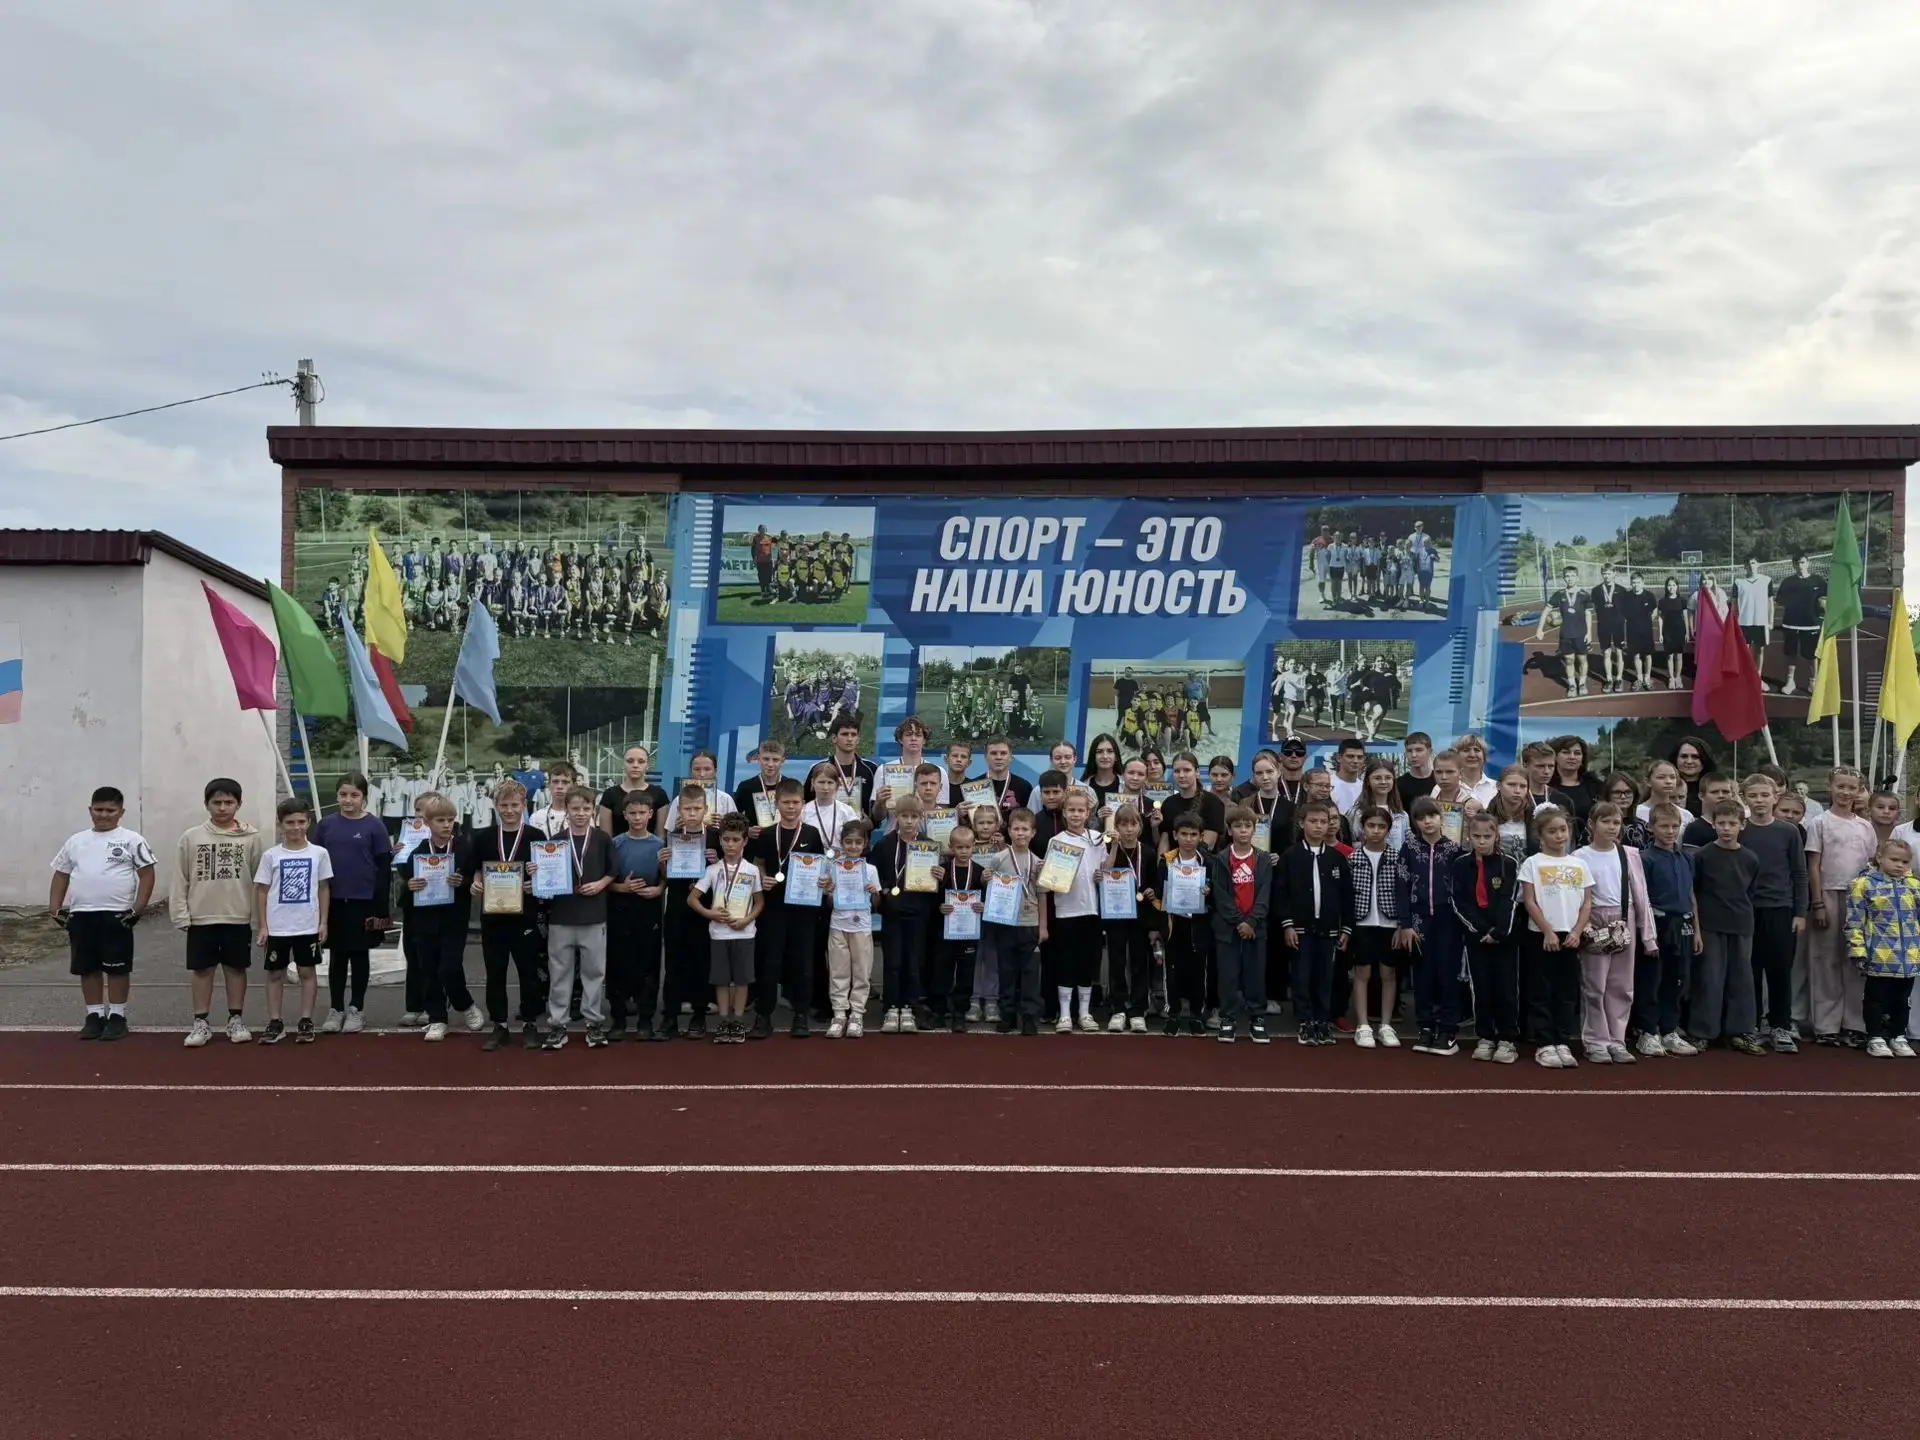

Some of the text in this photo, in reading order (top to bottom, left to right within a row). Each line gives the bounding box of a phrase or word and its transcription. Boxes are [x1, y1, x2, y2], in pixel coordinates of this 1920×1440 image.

[939, 516, 1087, 561] СПОРТ
[1136, 516, 1222, 561] ЭТО
[910, 568, 1247, 614] НАША ЮНОСТЬ
[310, 943, 317, 958] 7
